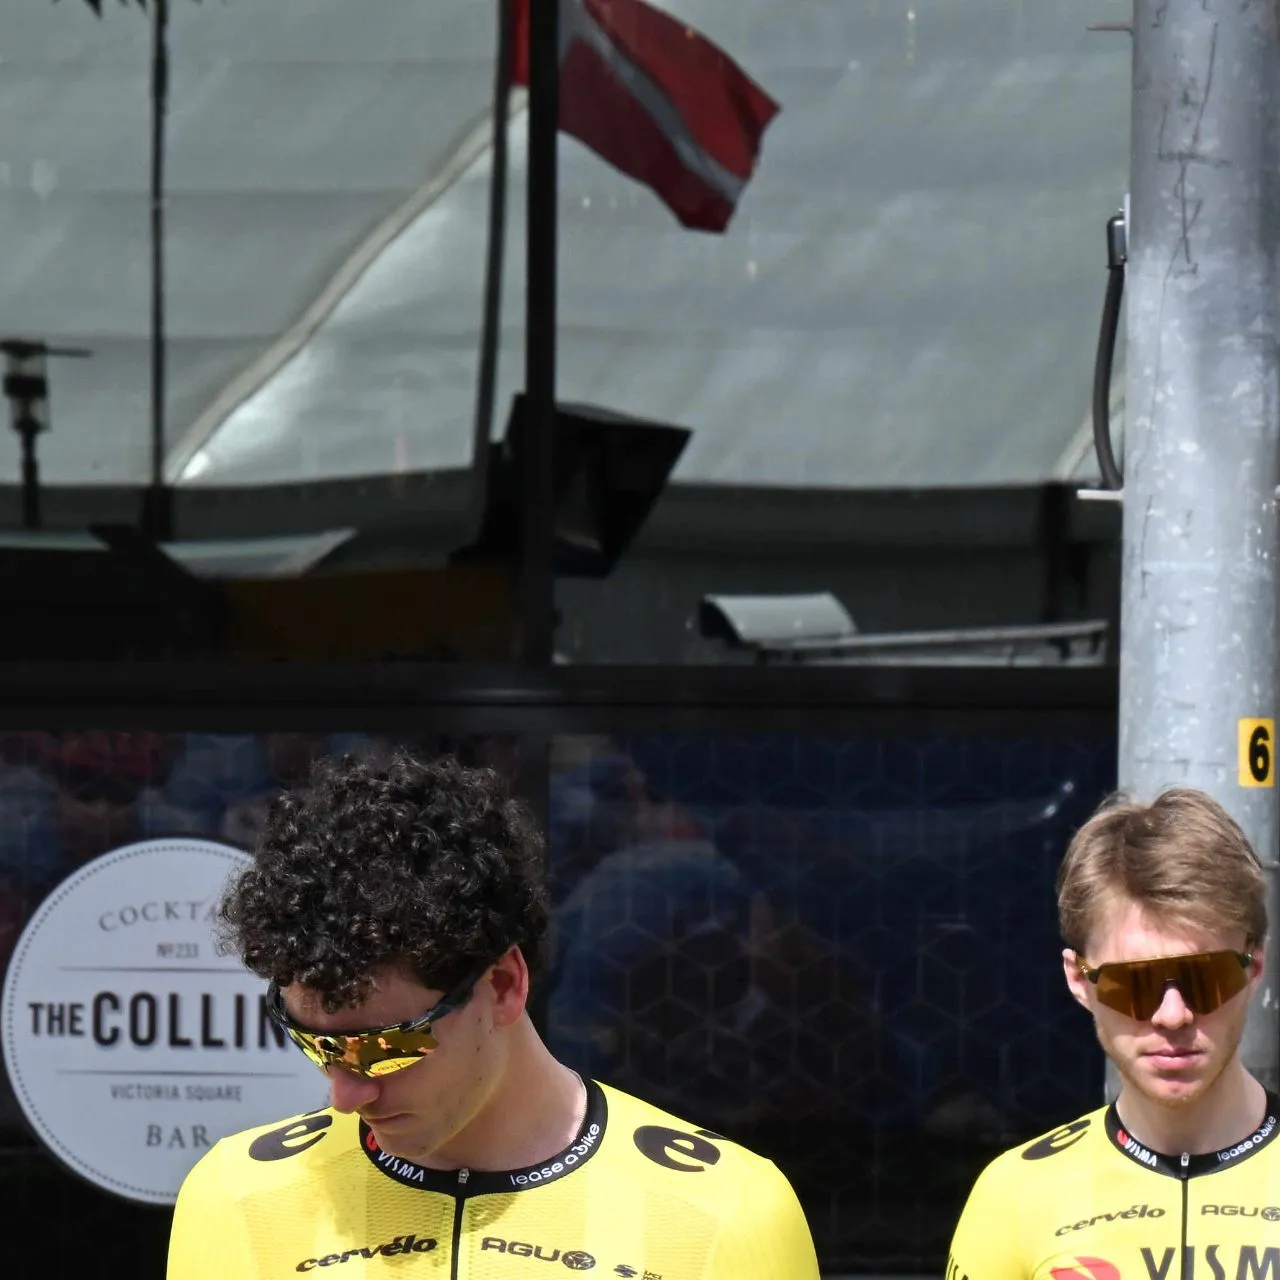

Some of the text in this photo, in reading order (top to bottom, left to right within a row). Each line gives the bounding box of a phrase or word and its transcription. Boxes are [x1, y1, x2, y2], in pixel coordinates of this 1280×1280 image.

[1249, 726, 1270, 782] 6
[28, 1003, 84, 1037] THE
[110, 1083, 243, 1104] VICTORIA SQUARE
[145, 1124, 211, 1150] BAR
[509, 1161, 564, 1186] lease
[1054, 1204, 1166, 1237] cervélo
[1200, 1204, 1259, 1218] AGU
[295, 1234, 439, 1273] cervélo
[481, 1237, 560, 1262] AGU
